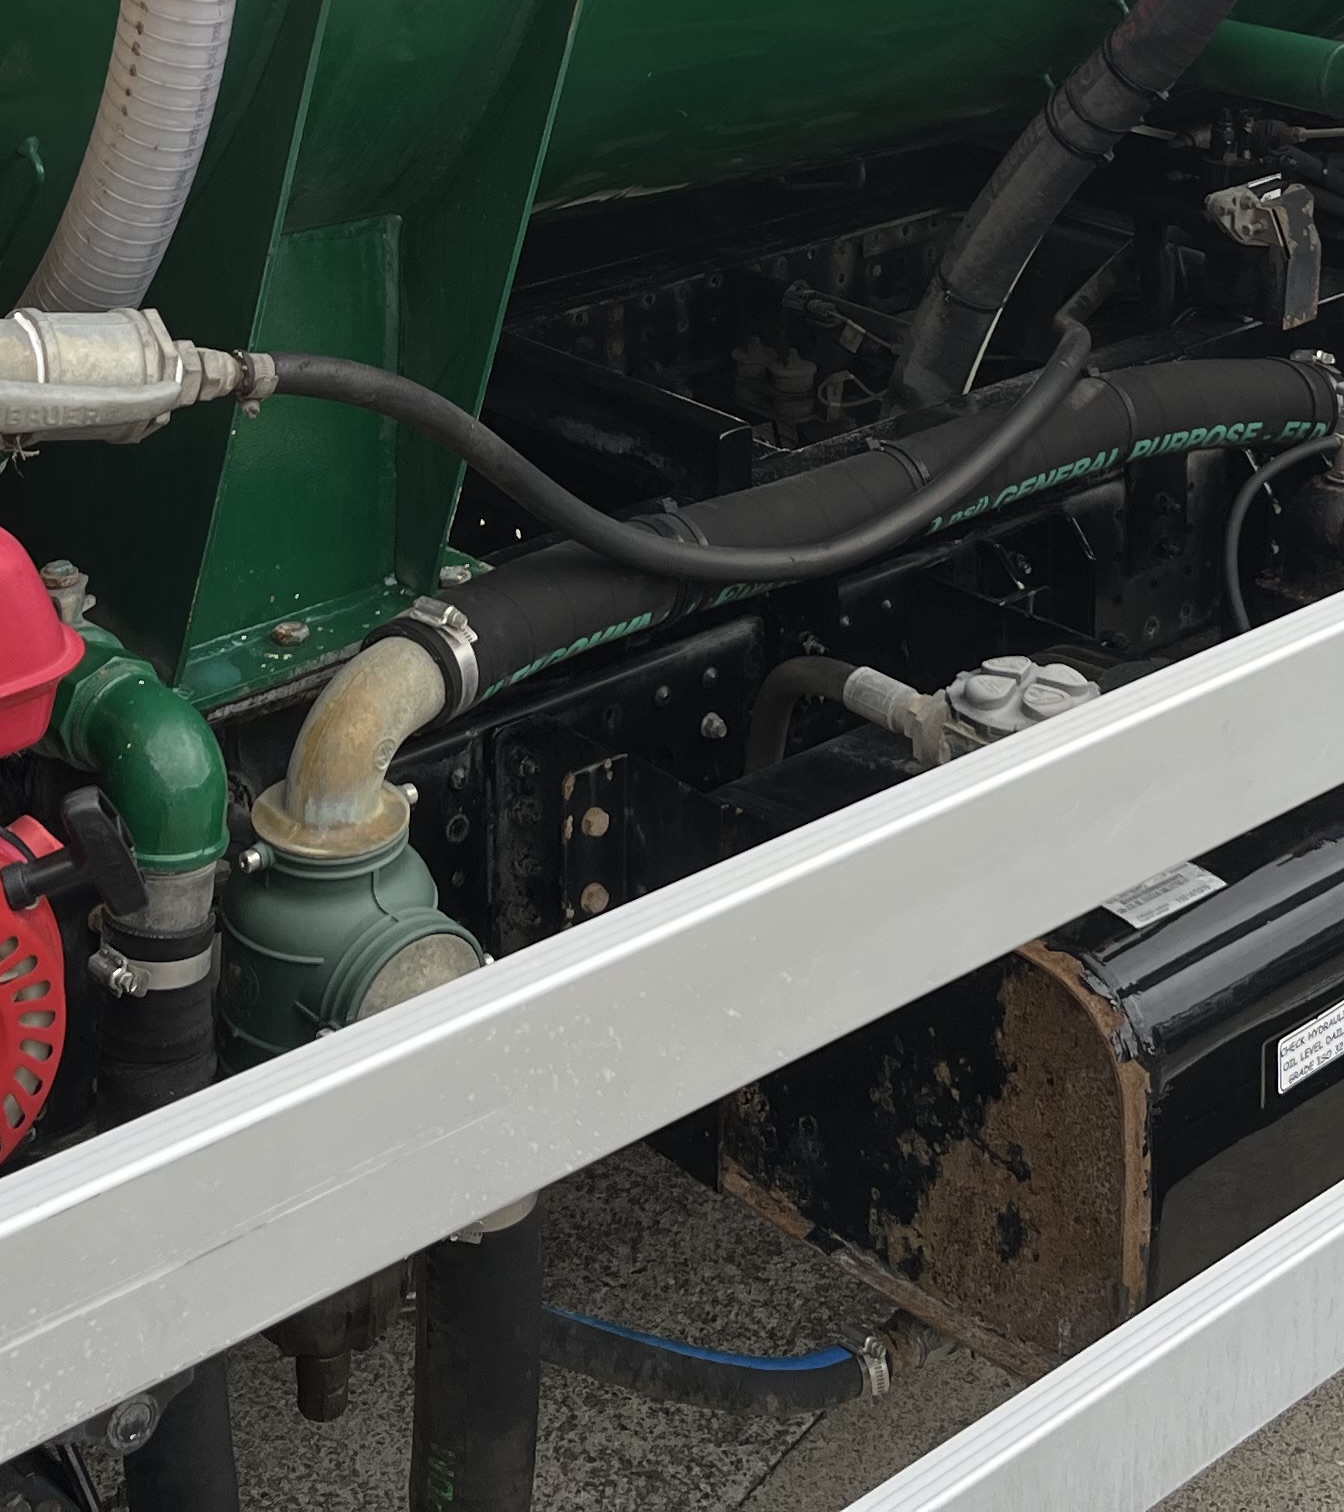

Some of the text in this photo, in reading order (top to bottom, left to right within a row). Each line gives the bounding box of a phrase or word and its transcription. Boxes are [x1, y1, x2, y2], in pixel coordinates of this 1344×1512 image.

[5, 406, 101, 426] BAUER
[994, 447, 1119, 509] GENERAL
[1127, 422, 1263, 463] PURPOSE
[1281, 1036, 1306, 1057] CHECK
[1283, 1057, 1297, 1072] OIL
[1300, 1041, 1323, 1061] LEVEL
[1289, 1060, 1314, 1084] GRADE
